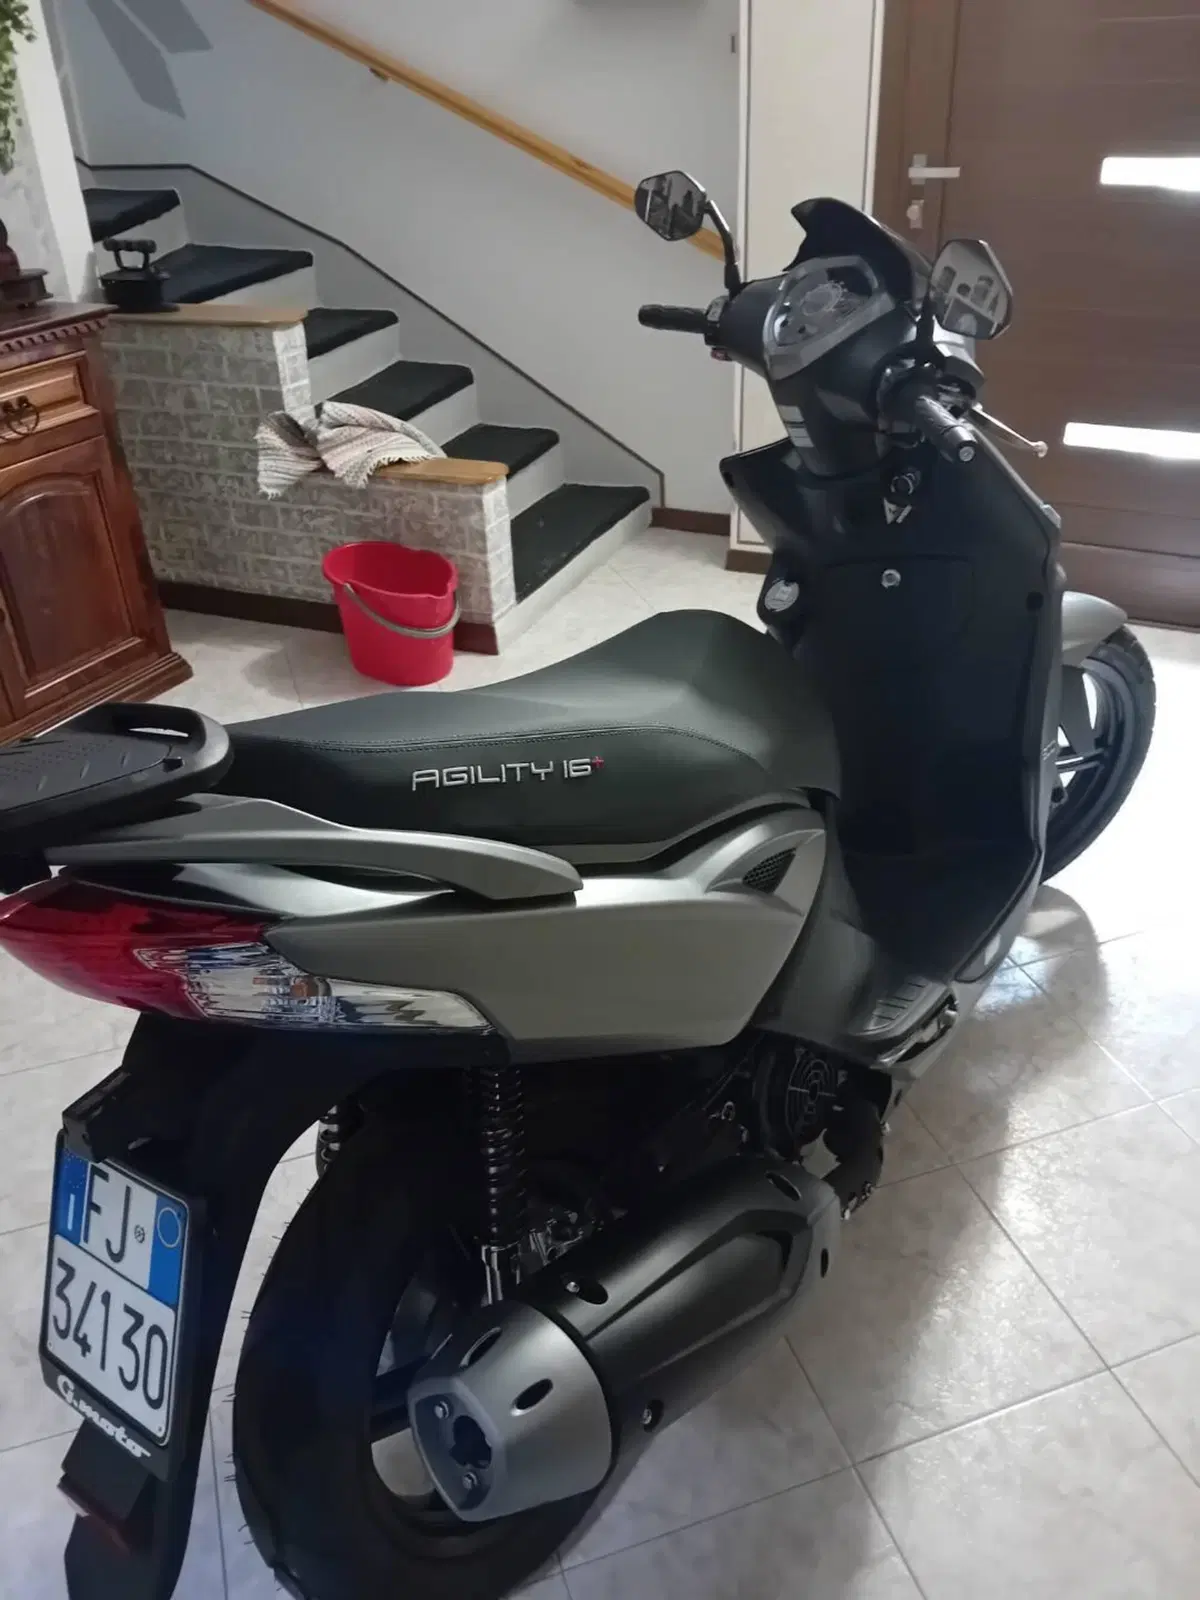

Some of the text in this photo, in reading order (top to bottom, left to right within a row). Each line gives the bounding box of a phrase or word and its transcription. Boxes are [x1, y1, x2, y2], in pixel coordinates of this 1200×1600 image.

[411, 760, 554, 792] AGILITY
[82, 1163, 132, 1264] FJ
[52, 1257, 169, 1411] 34130
